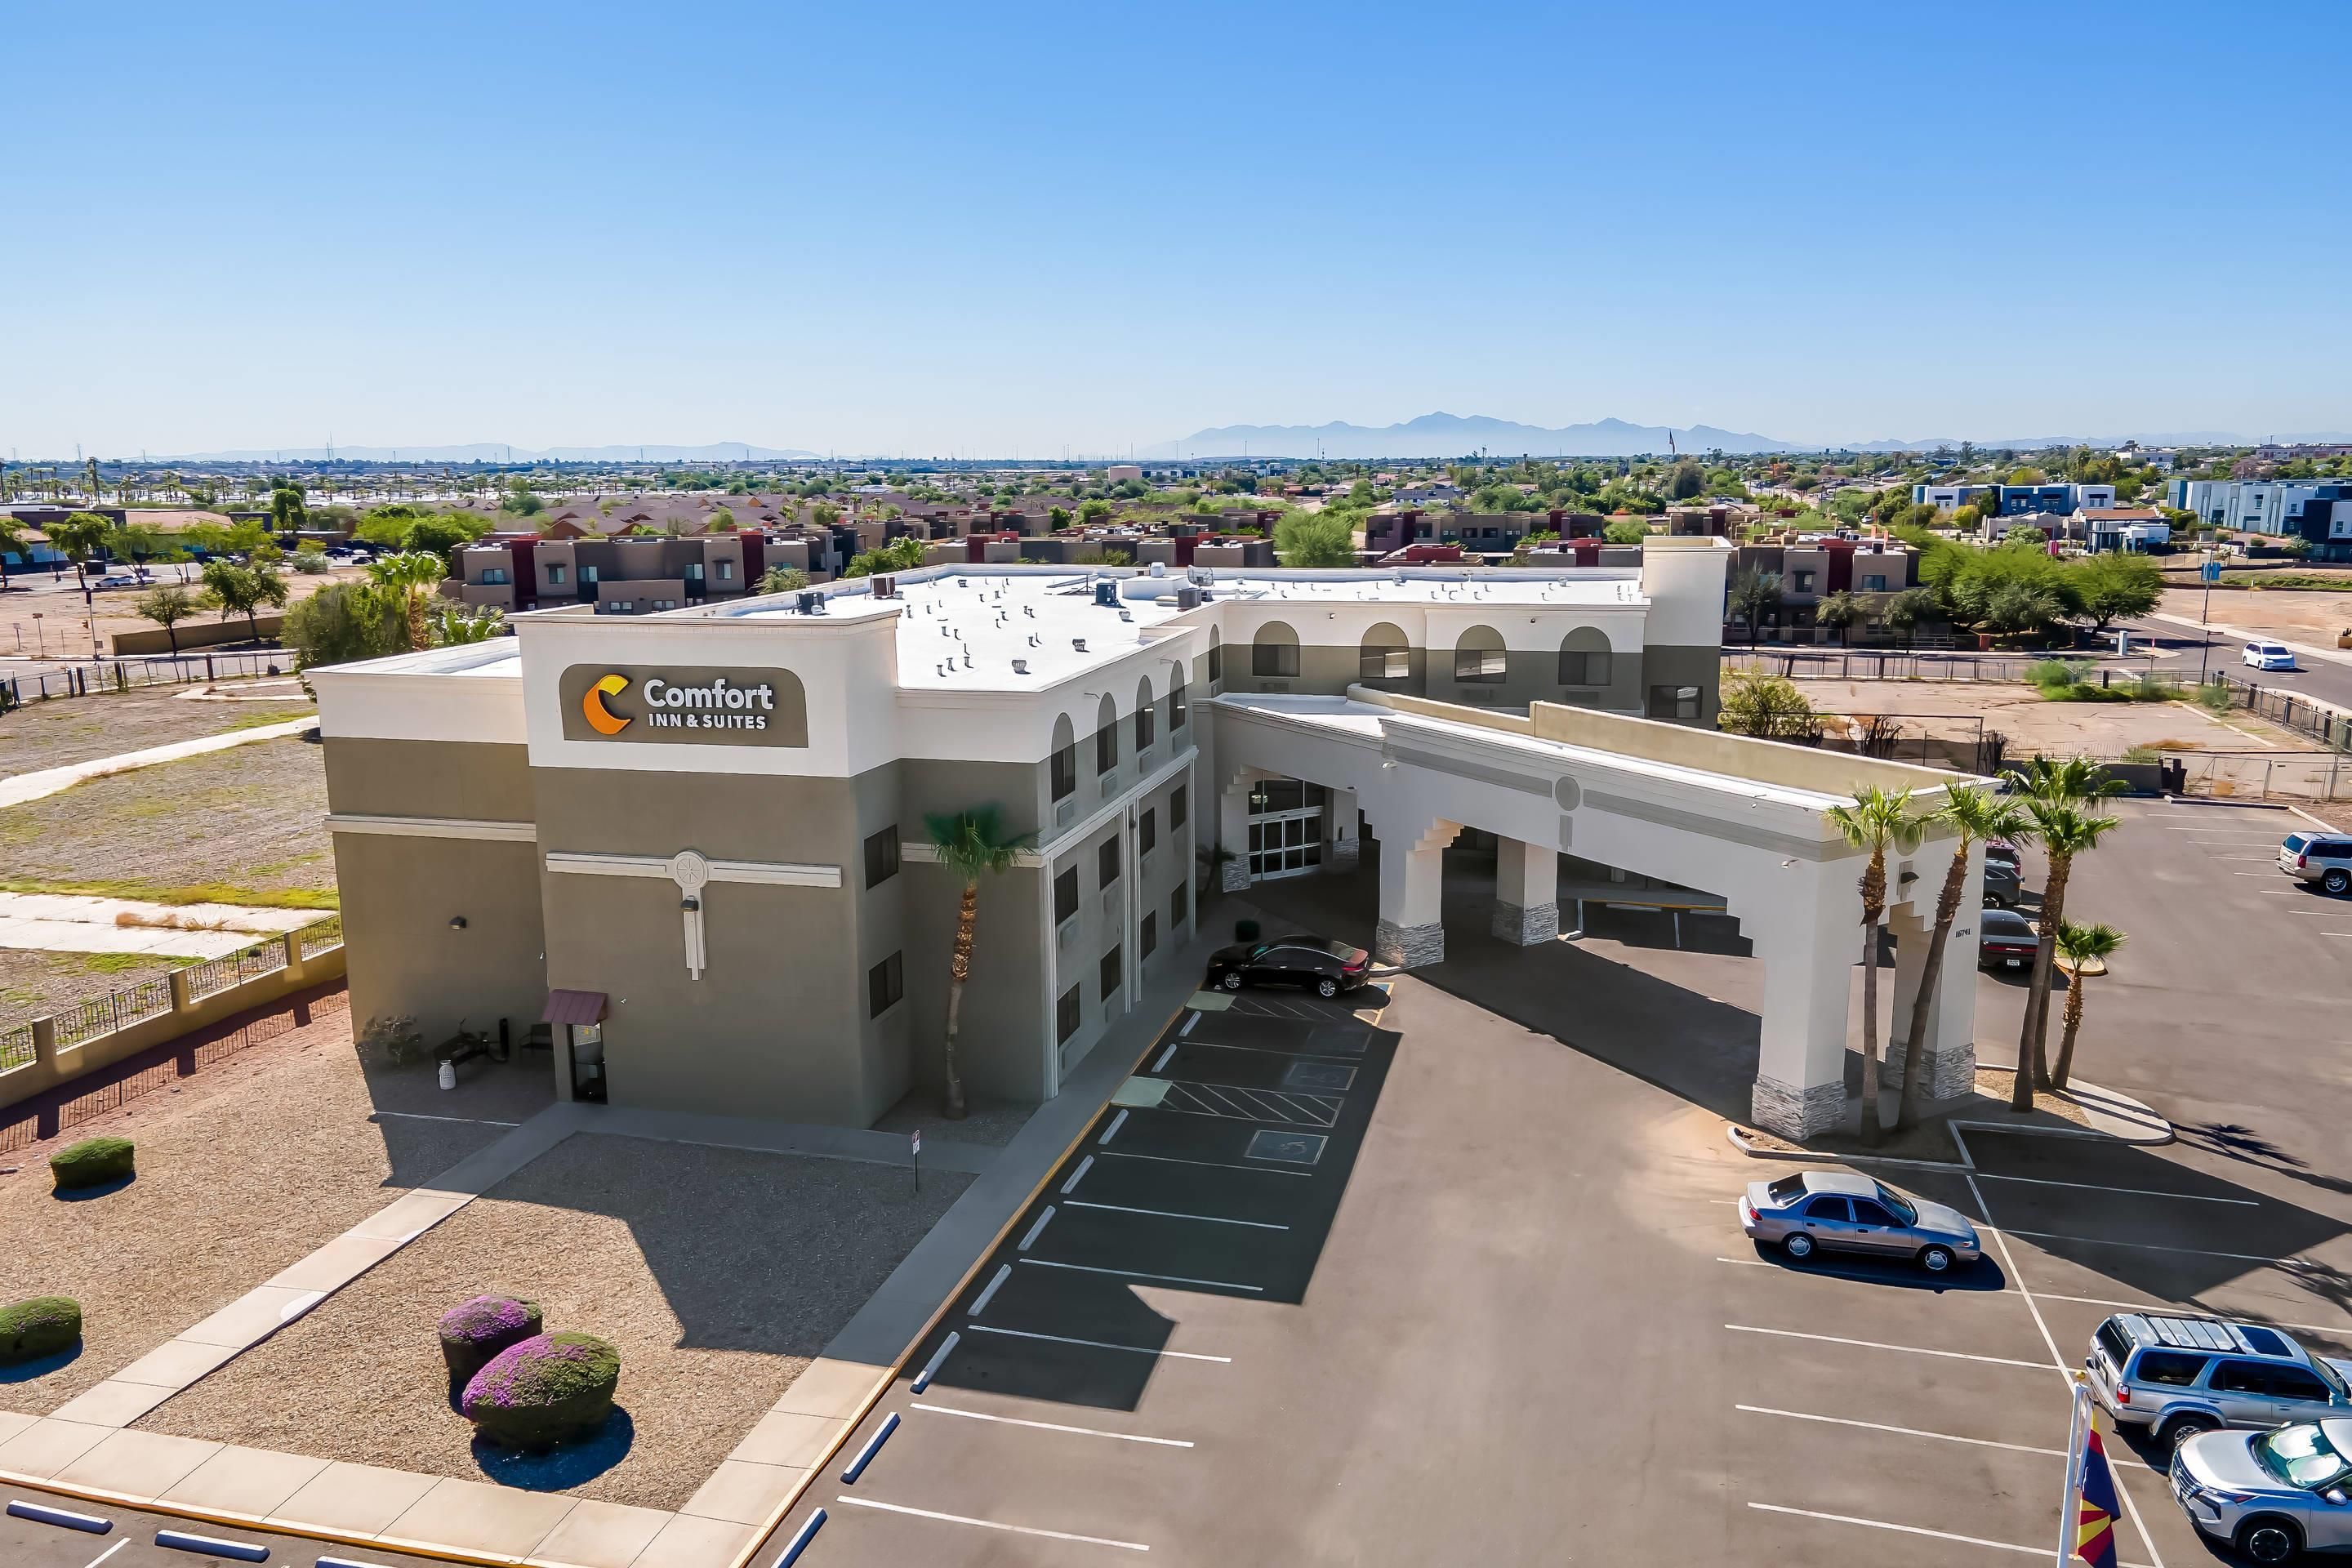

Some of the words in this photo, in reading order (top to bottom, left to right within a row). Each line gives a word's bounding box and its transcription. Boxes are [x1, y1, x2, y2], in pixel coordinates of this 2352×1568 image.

[644, 679, 773, 710] Comfort
[648, 713, 681, 727] INN
[686, 714, 699, 728] &
[702, 715, 766, 729] SUITES
